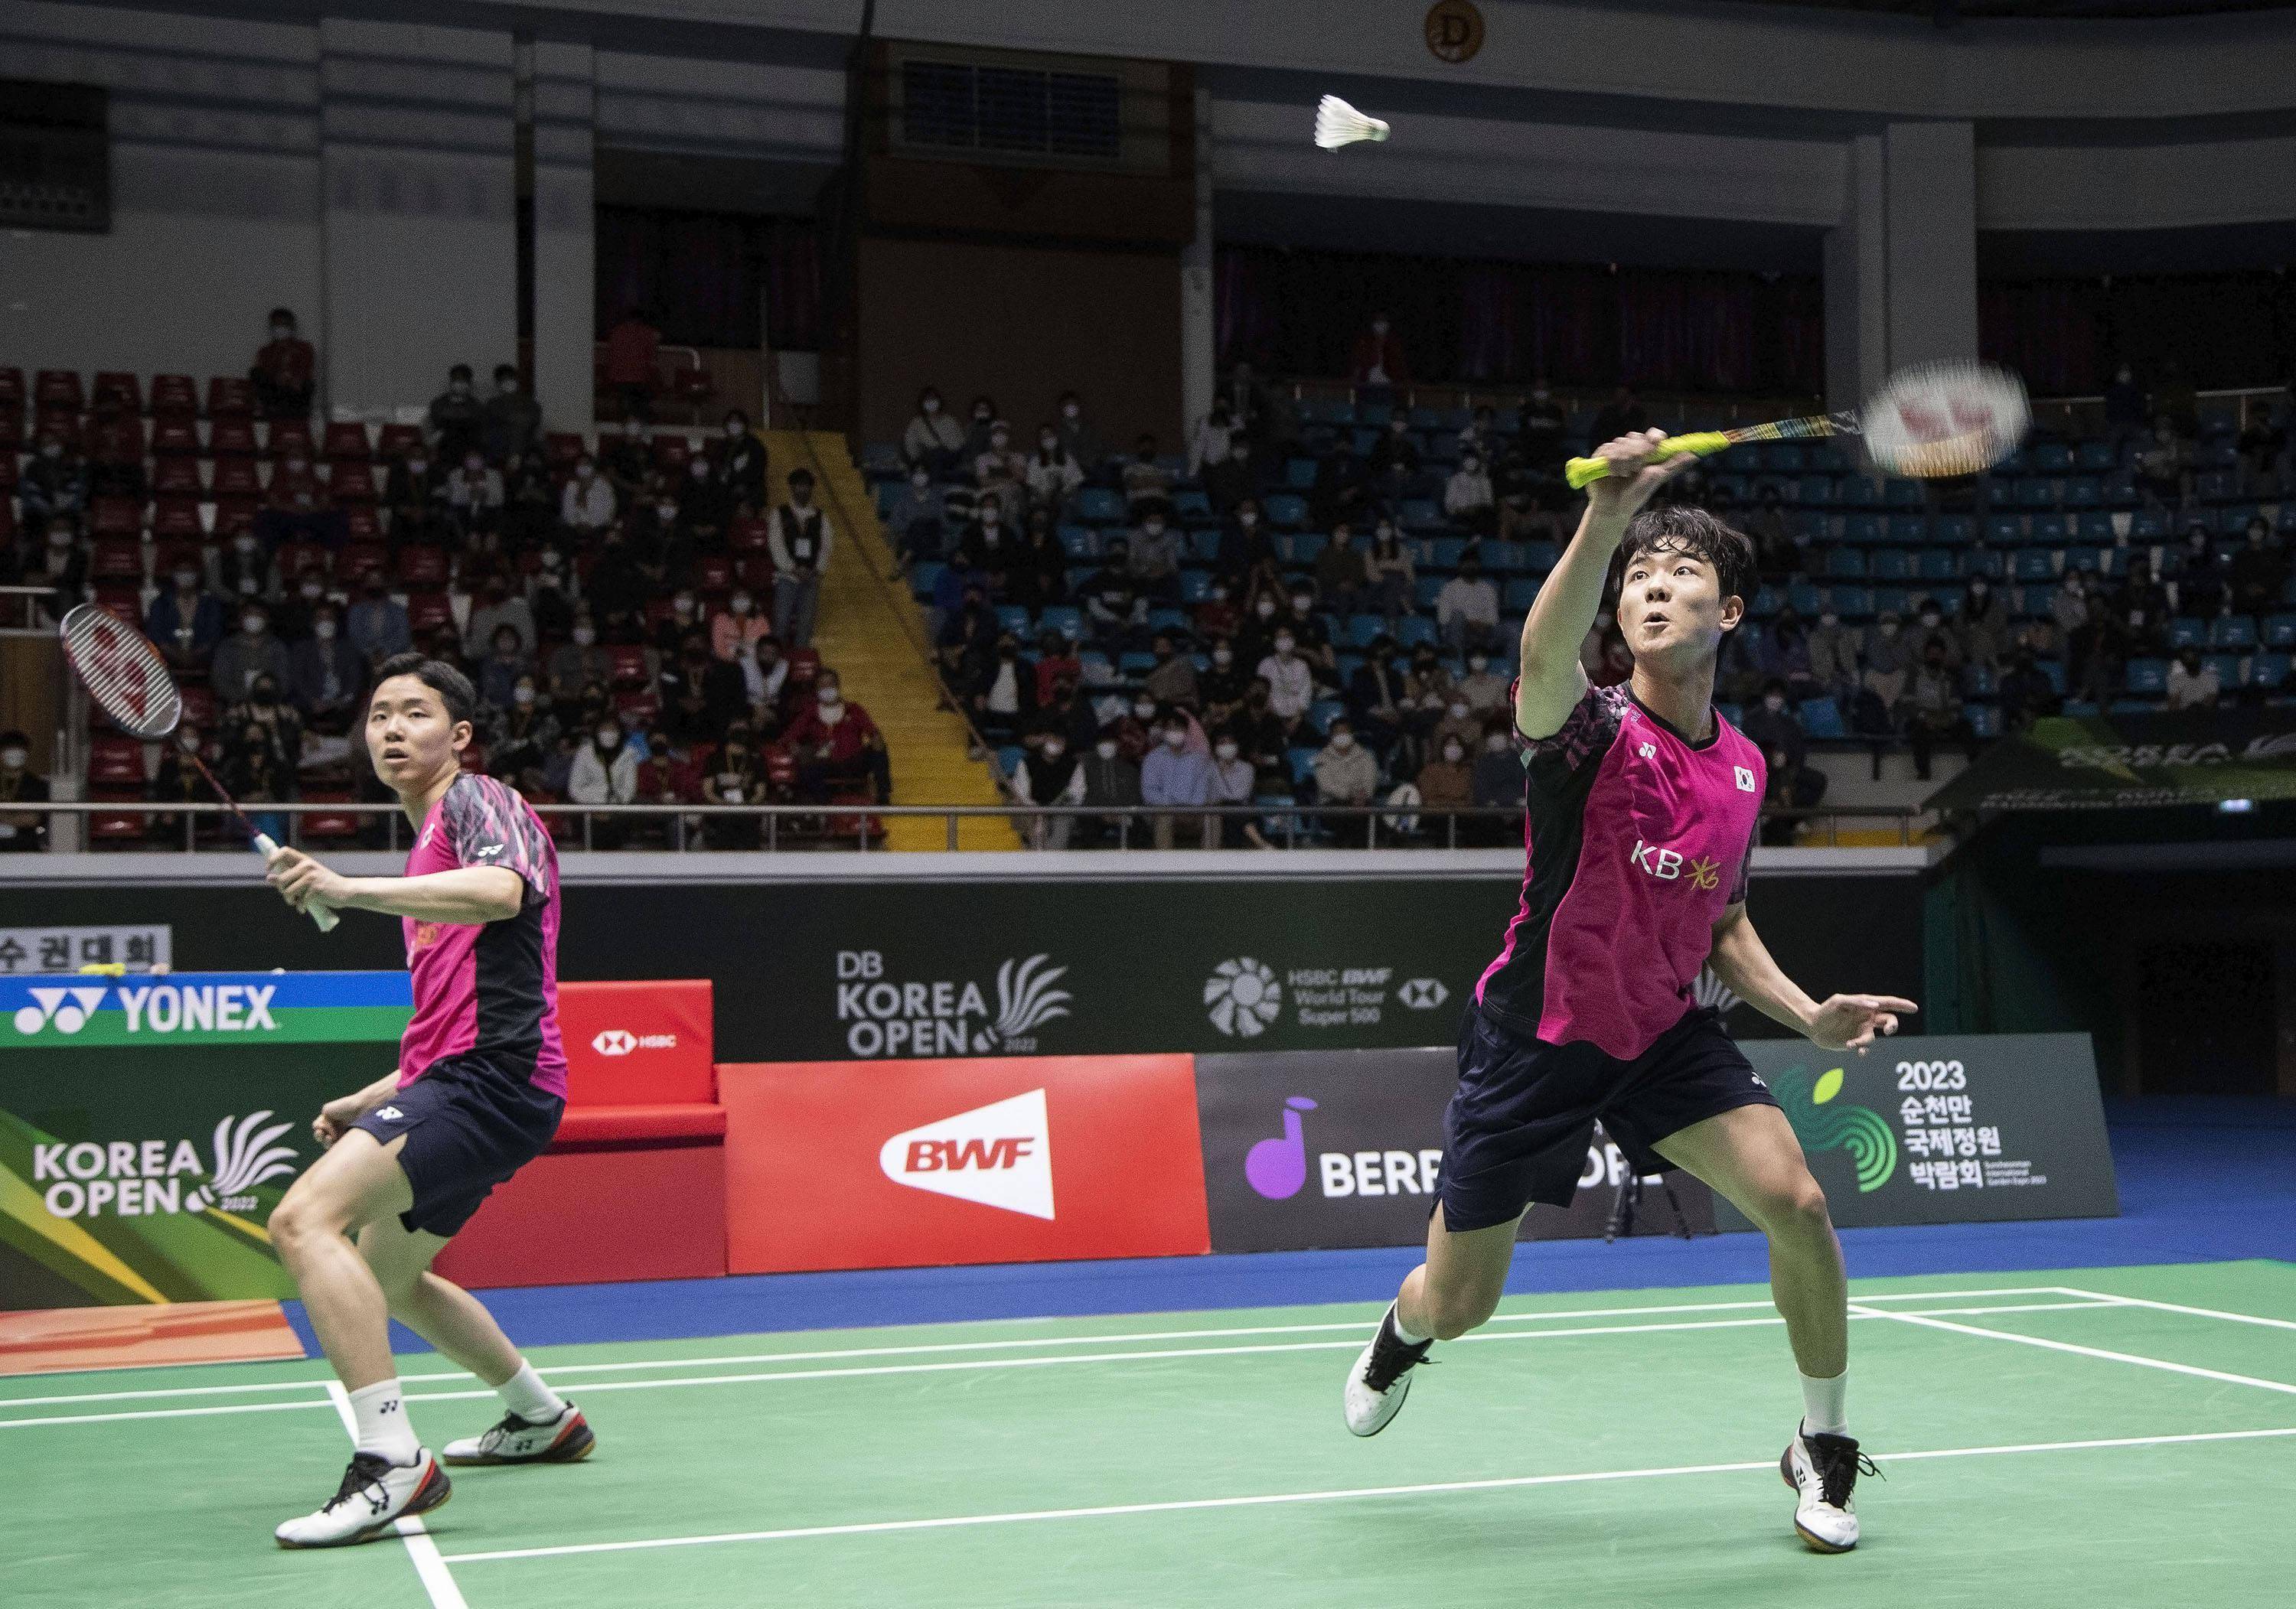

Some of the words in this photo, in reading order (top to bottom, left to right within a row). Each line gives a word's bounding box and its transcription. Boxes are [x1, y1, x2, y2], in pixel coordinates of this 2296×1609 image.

[1440, 13, 1471, 46] D
[1630, 839, 1684, 880] KB
[837, 950, 884, 979] DB
[1287, 969, 1338, 987] HSBC
[118, 984, 276, 1032] YONEX
[837, 982, 988, 1019] KOREA
[1293, 989, 1345, 1006] World
[1347, 989, 1385, 1005] Tour
[1299, 1008, 1348, 1027] Super
[847, 1019, 968, 1057] OPEN
[1896, 1060, 1967, 1091] 2023
[1900, 1094, 1973, 1125] 순천만
[905, 1136, 1035, 1172] BWF
[1904, 1126, 2002, 1158] 국제정원
[34, 1139, 204, 1181] KOREA
[1319, 1149, 1443, 1197] BERR
[1910, 1159, 1984, 1190] 박람회
[44, 1178, 181, 1219] OPEN
[219, 1194, 259, 1211] 2022
